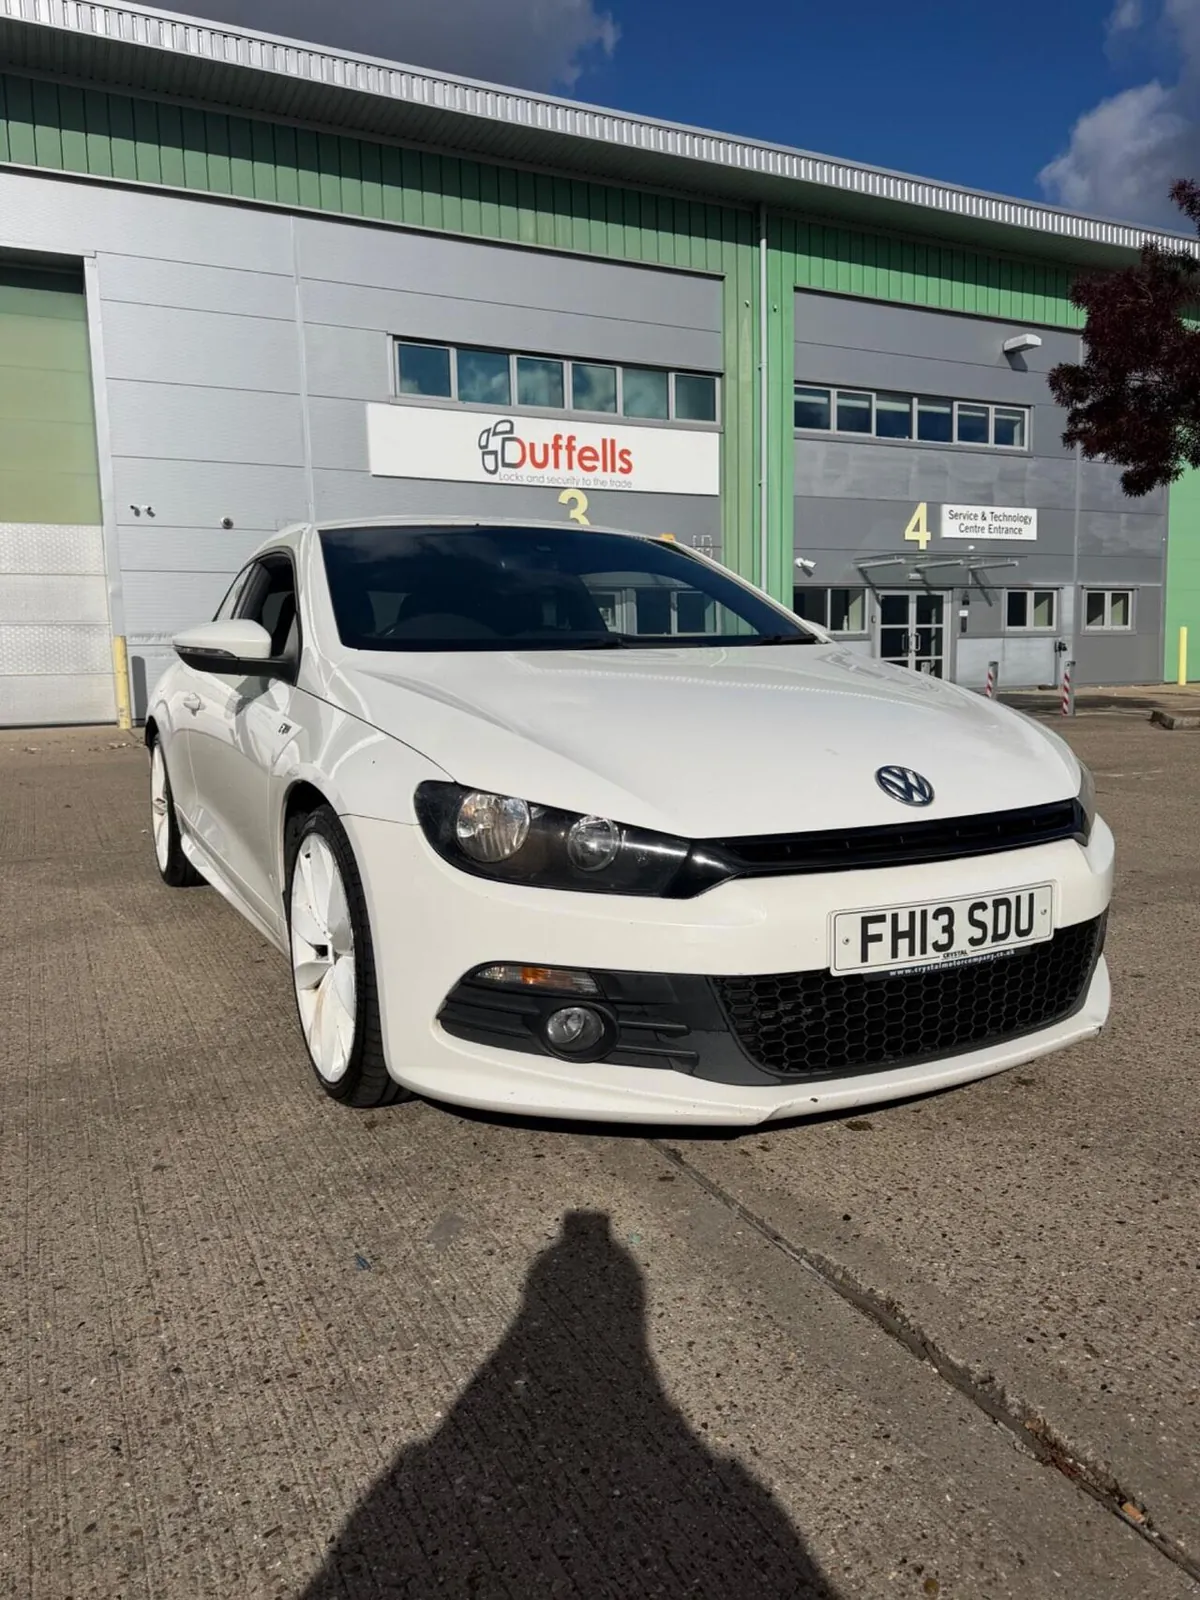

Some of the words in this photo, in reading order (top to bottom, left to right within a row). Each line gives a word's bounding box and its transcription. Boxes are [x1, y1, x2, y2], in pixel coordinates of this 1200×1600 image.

[501, 433, 633, 475] Duffells
[498, 471, 524, 482] Locks
[526, 472, 545, 484] and
[547, 475, 580, 487] security
[582, 476, 592, 486] to
[593, 477, 608, 488] the
[609, 479, 633, 489] trade
[904, 502, 931, 550] 4
[948, 509, 979, 520] Service
[981, 511, 987, 521] &
[989, 511, 1032, 525] Technology
[959, 523, 985, 534] Centre
[988, 524, 1023, 535] Entrance
[860, 906, 955, 963] FH13
[967, 892, 1035, 947] SDU
[942, 949, 968, 959] CRYSTAL
